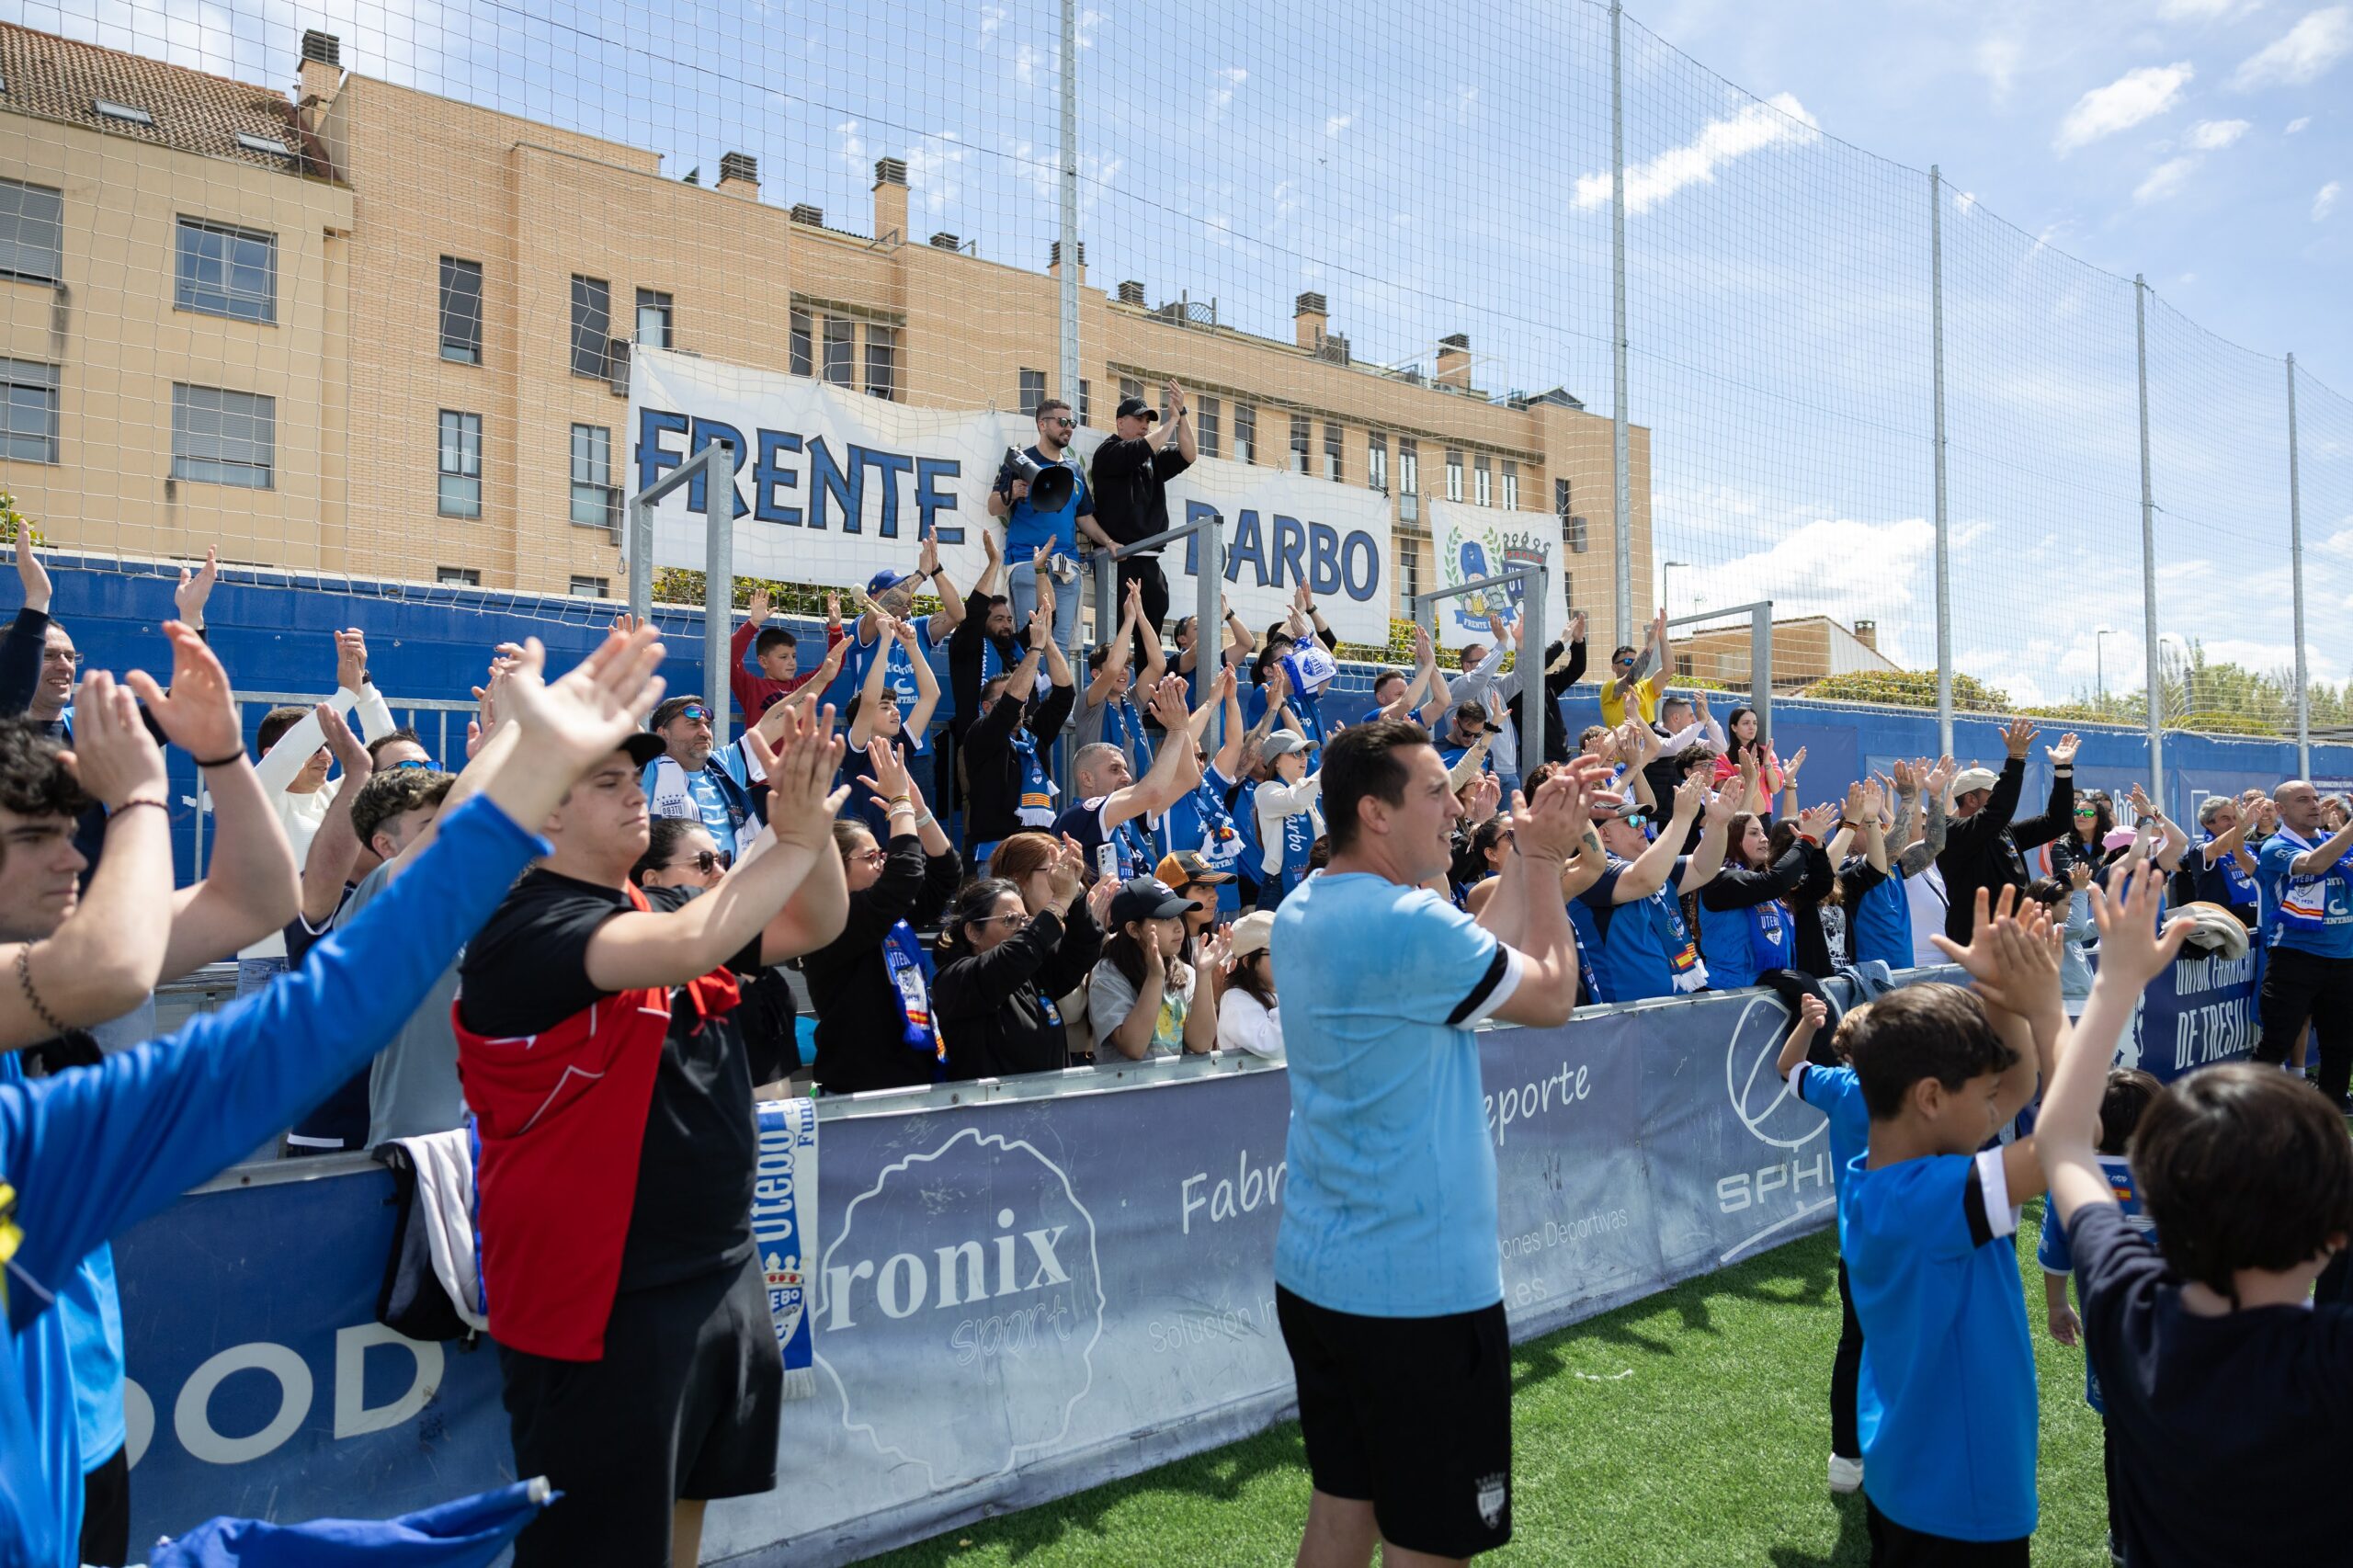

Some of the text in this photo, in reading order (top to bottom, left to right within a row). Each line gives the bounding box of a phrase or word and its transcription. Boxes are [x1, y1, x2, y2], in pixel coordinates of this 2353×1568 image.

[634, 406, 966, 545] FRENTE
[1463, 618, 1488, 630] FRENTE
[2175, 1009, 2199, 1071] DE
[1182, 1149, 1287, 1234] Fabr
[1544, 1207, 1629, 1249] Deportivas
[825, 1208, 1071, 1333] ronix
[950, 1294, 1071, 1385] sport
[1149, 1301, 1252, 1354] Solución
